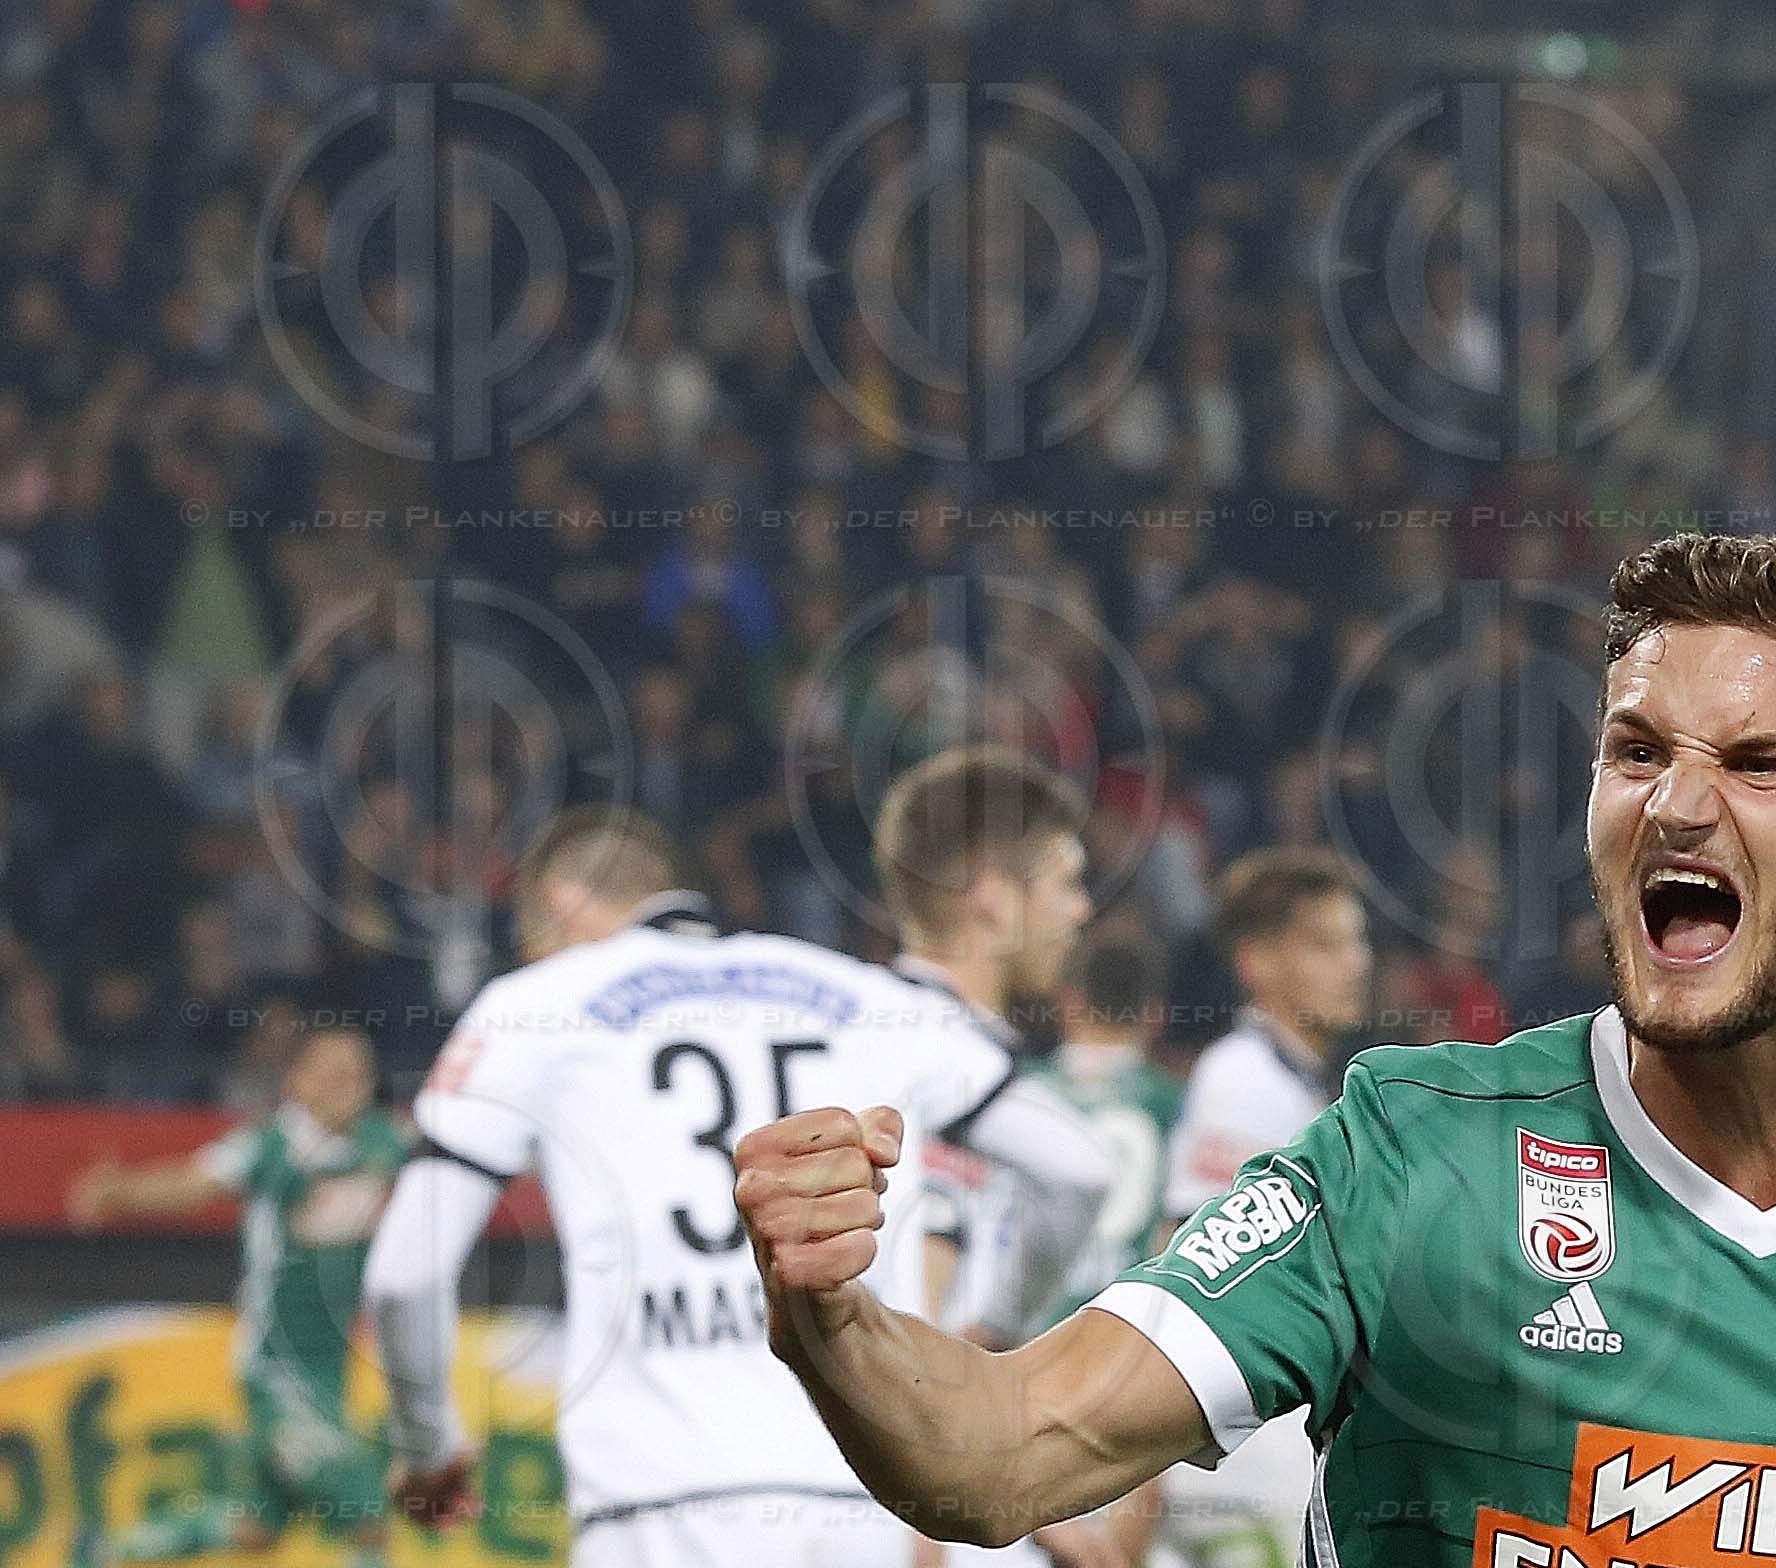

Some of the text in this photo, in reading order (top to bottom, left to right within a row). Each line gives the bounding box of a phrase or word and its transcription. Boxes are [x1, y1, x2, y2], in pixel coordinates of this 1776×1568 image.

[1526, 1141, 1600, 1172] tipico
[1525, 1174, 1602, 1198] BUNDES
[1540, 1194, 1584, 1210] LIGA
[1518, 1323, 1624, 1354] adidas
